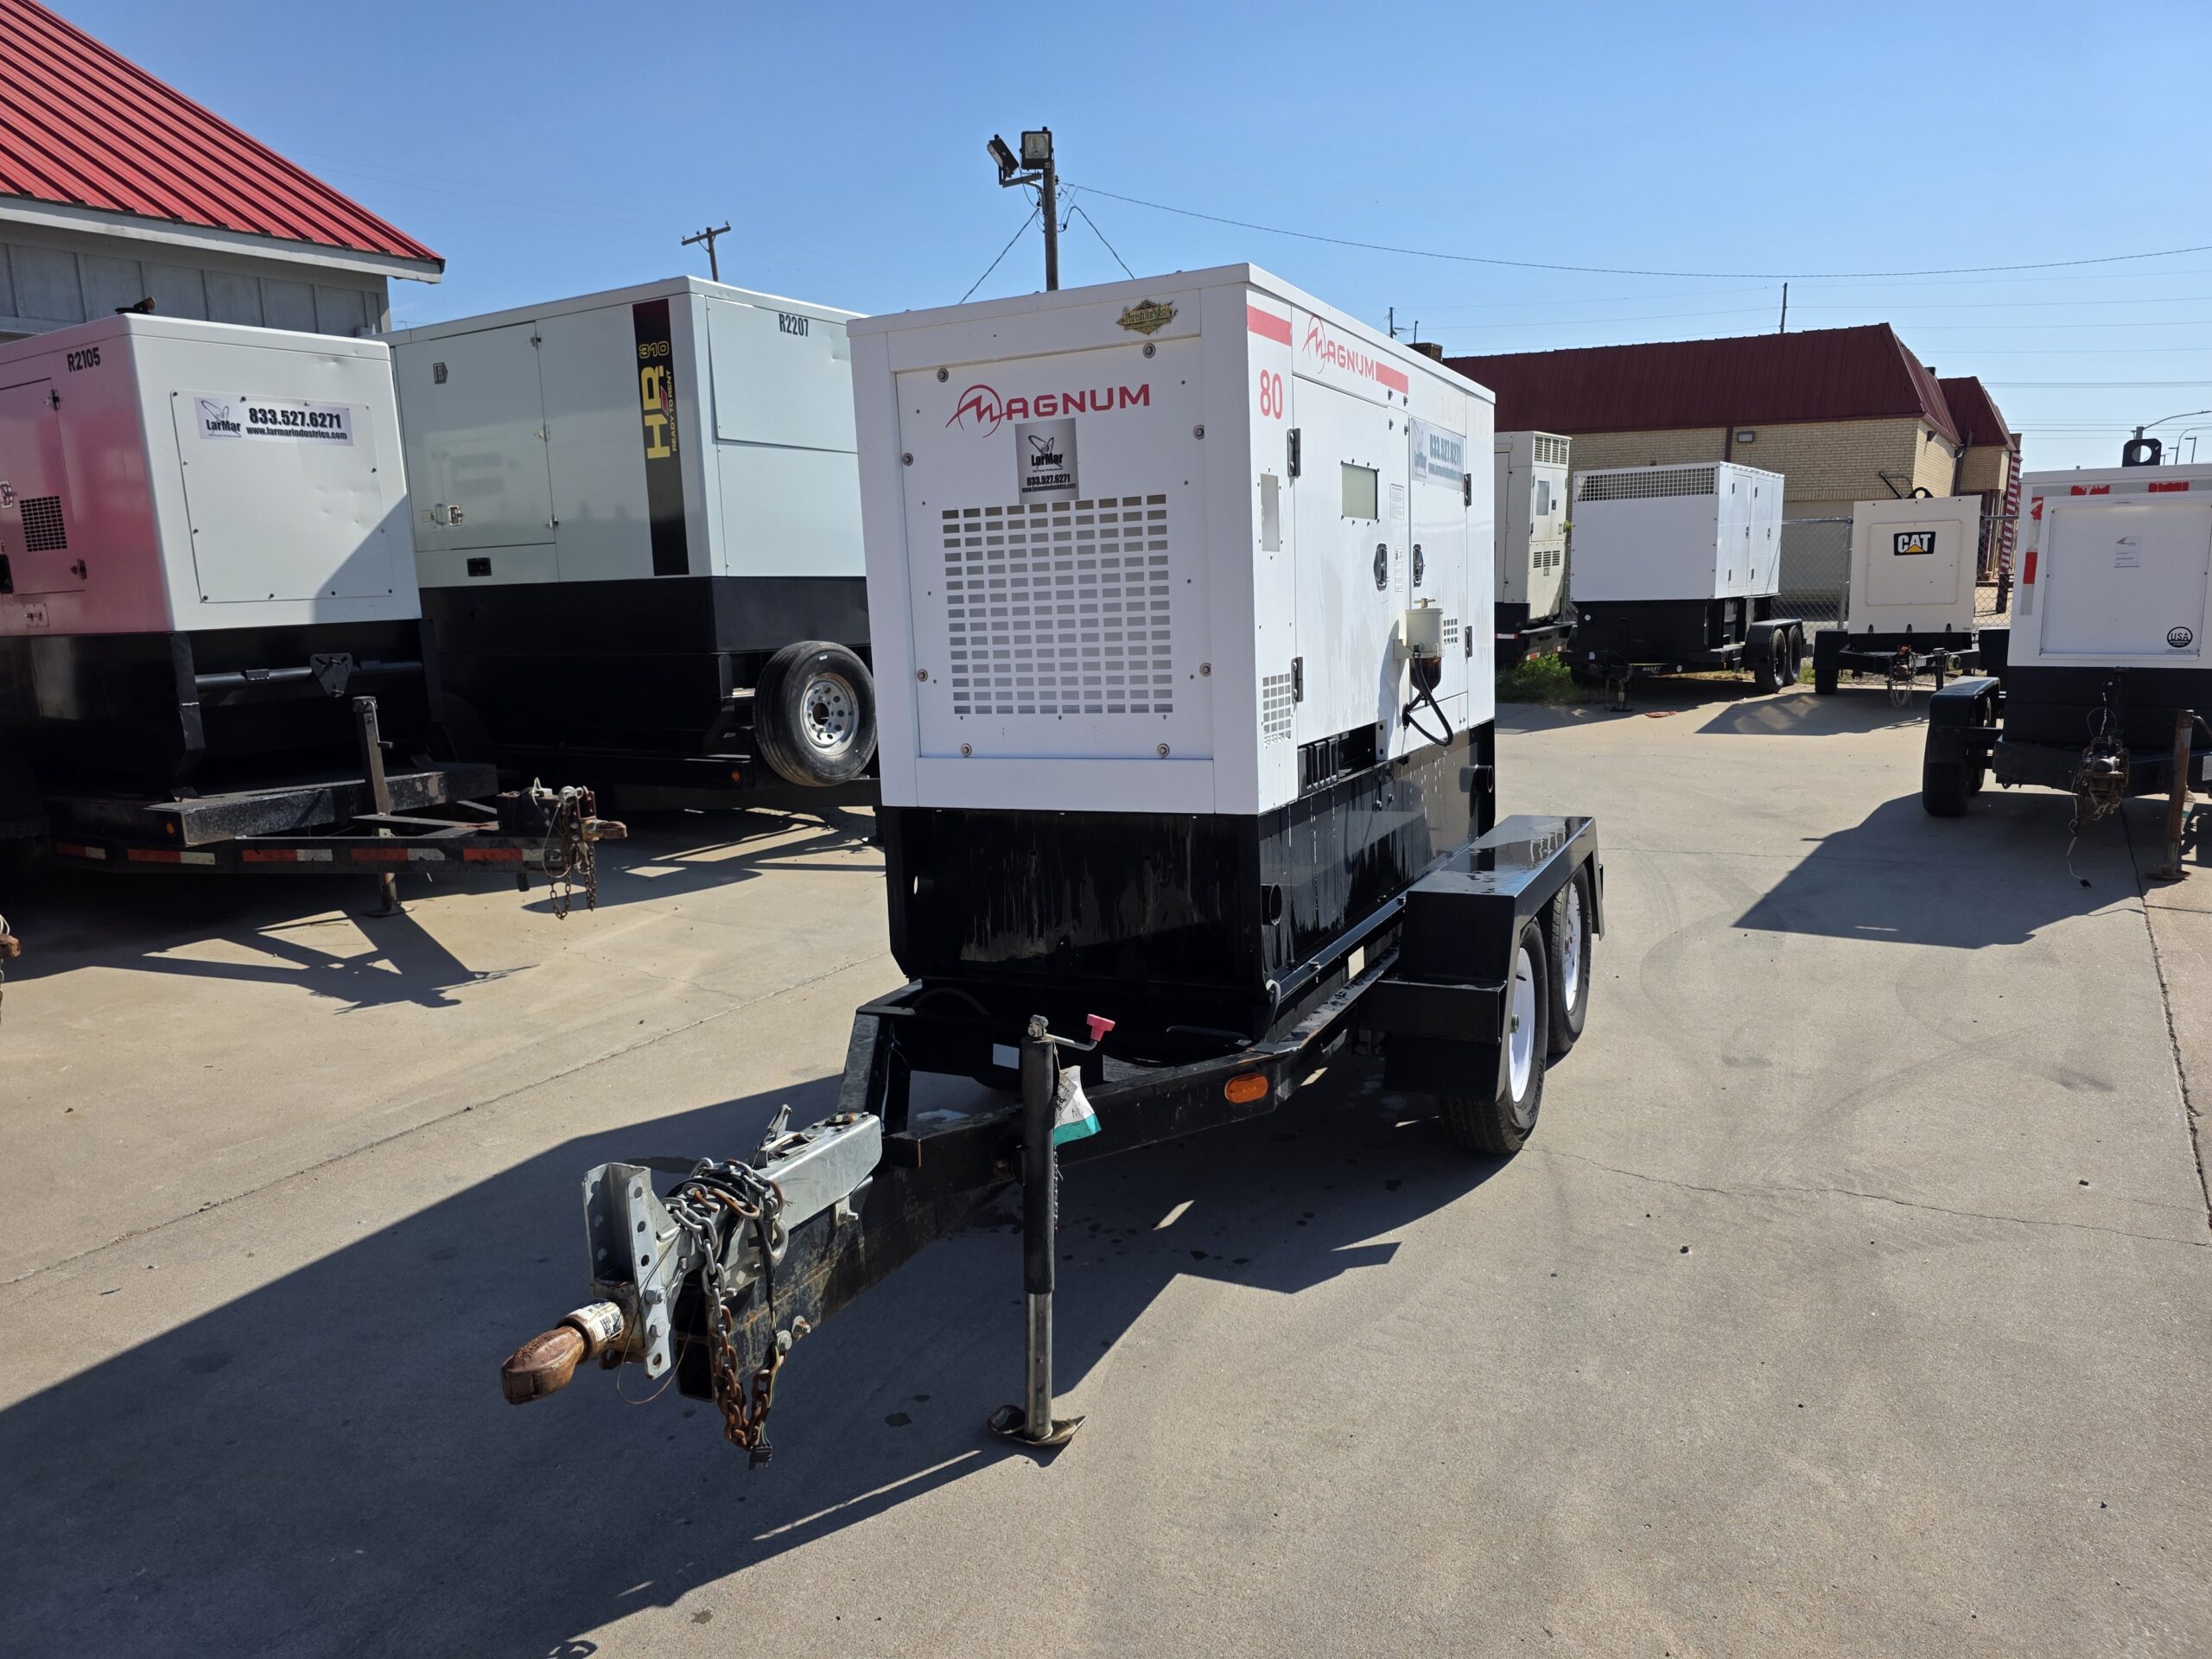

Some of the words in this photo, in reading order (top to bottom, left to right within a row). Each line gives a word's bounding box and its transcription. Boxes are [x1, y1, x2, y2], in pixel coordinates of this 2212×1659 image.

[779, 313, 809, 337] R2207
[639, 341, 670, 359] 310
[1302, 316, 1375, 380] MAGNUM
[67, 346, 101, 372] R2105
[1260, 369, 1283, 420] 80
[249, 408, 342, 429] 833.527.6271
[945, 384, 1150, 438] MAGNUM
[206, 419, 241, 432] LarMar
[1031, 453, 1064, 467] LarMar
[1897, 533, 1931, 553] CAT
[2171, 632, 2189, 641] USA
